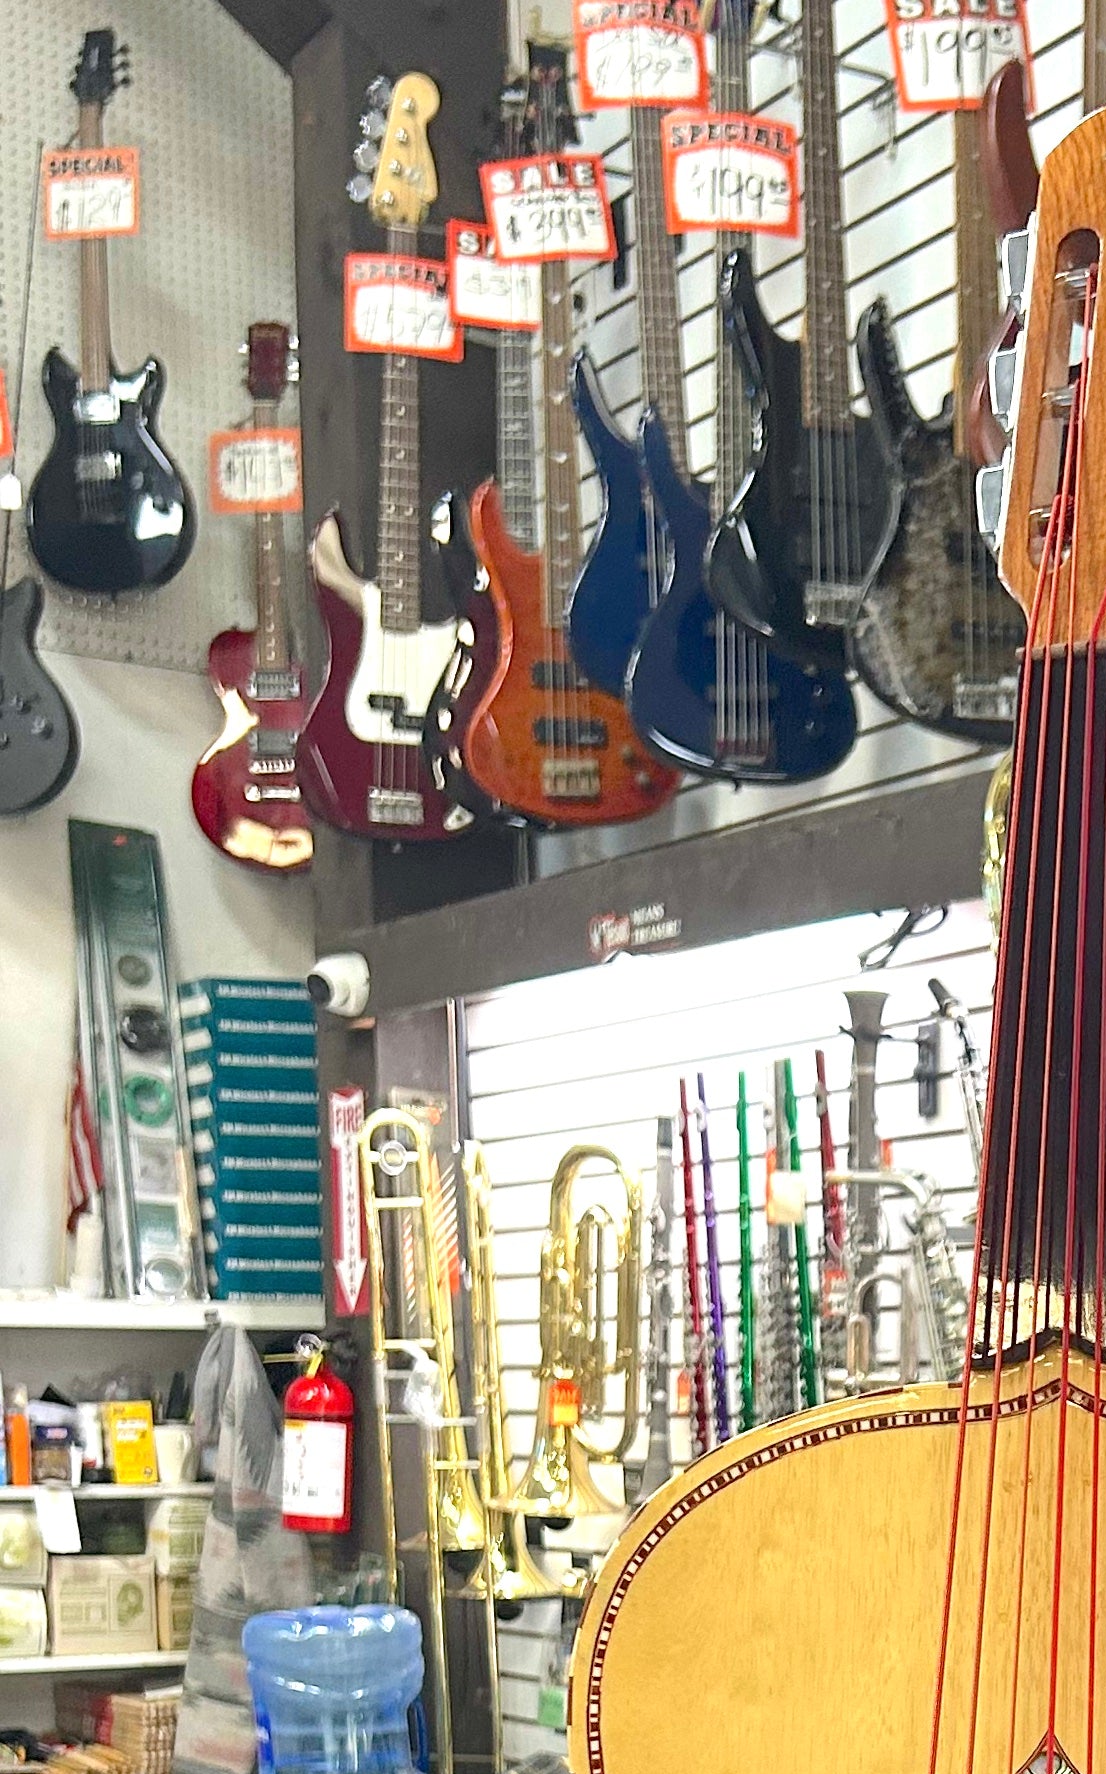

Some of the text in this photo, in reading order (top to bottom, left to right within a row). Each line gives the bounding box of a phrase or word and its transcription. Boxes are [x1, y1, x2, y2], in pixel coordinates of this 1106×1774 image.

[580, 1, 699, 30] SPECIAL
[894, 0, 1019, 20] SALE
[671, 122, 792, 156] SPECIAL
[49, 155, 124, 178] SPECIAL
[490, 160, 595, 195] SALE
[354, 262, 447, 288] SPECIA
[334, 1105, 362, 1134] FIRE
